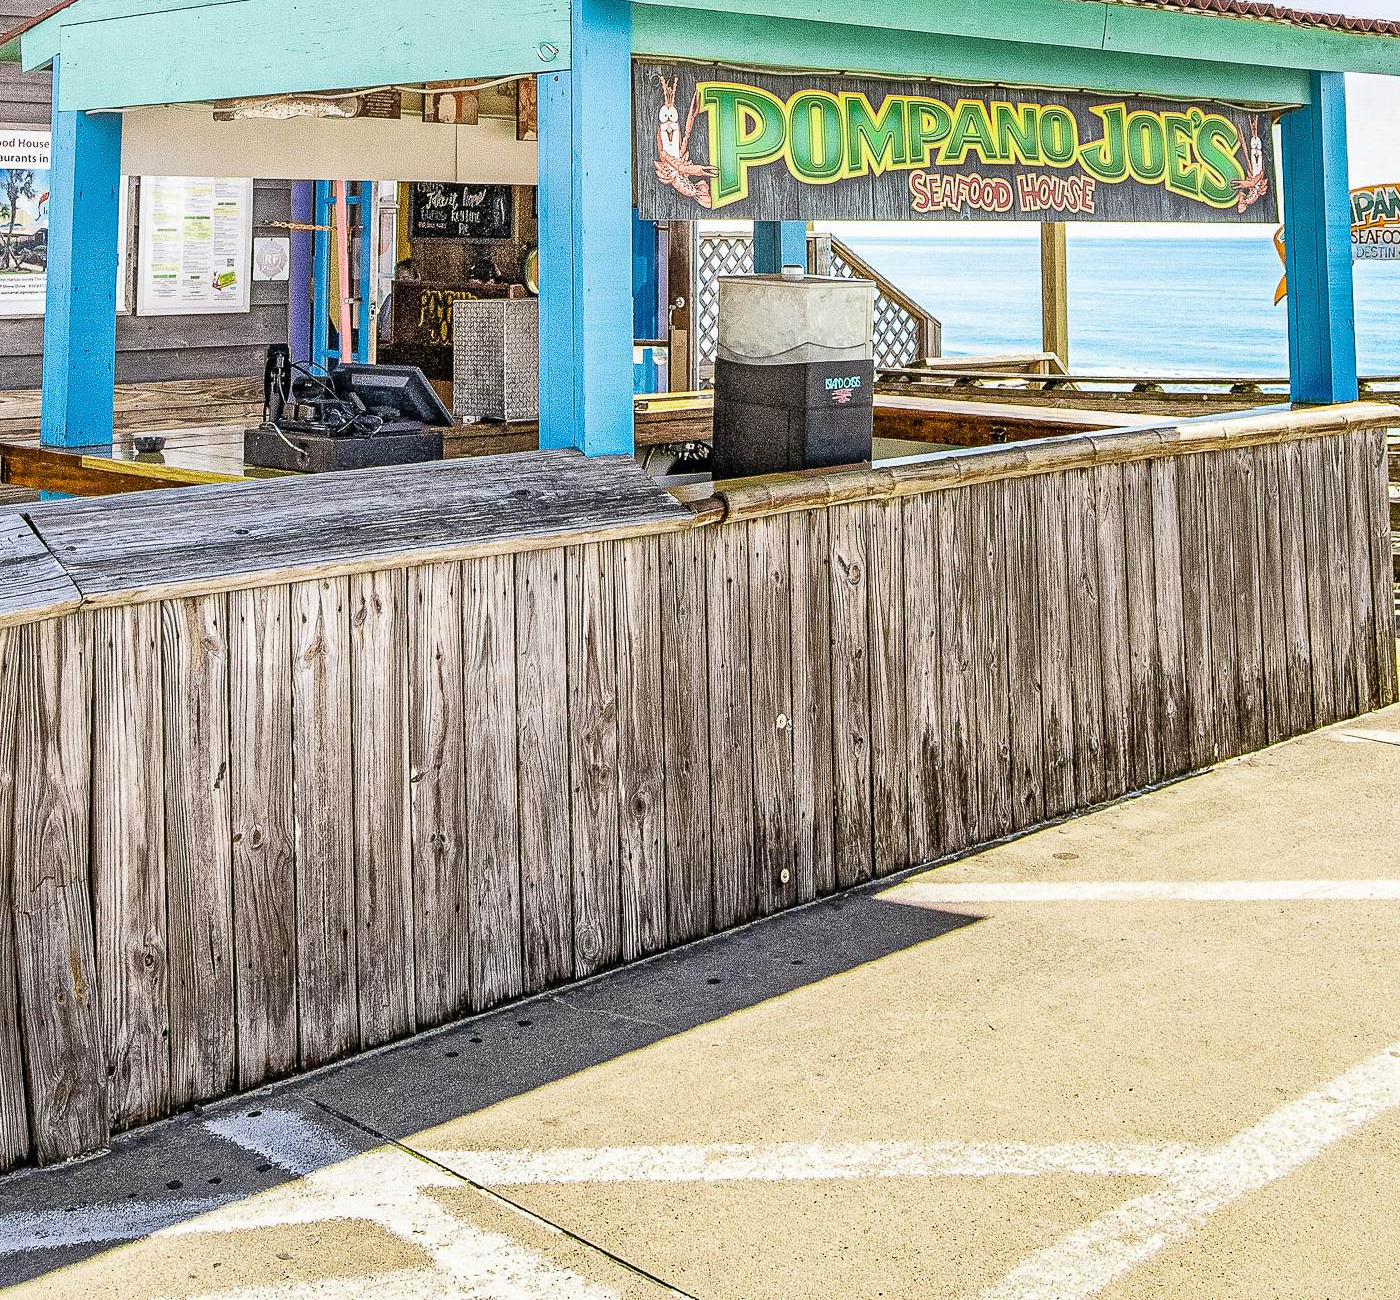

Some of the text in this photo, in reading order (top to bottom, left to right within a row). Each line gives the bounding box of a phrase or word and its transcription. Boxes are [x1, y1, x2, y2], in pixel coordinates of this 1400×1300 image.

[18, 138, 50, 148] House
[697, 82, 1246, 209] POMPANO JOE'S
[39, 153, 49, 163] in
[908, 170, 1096, 214] SEAFOOD HOUSE
[1356, 246, 1396, 258] DESTIN
